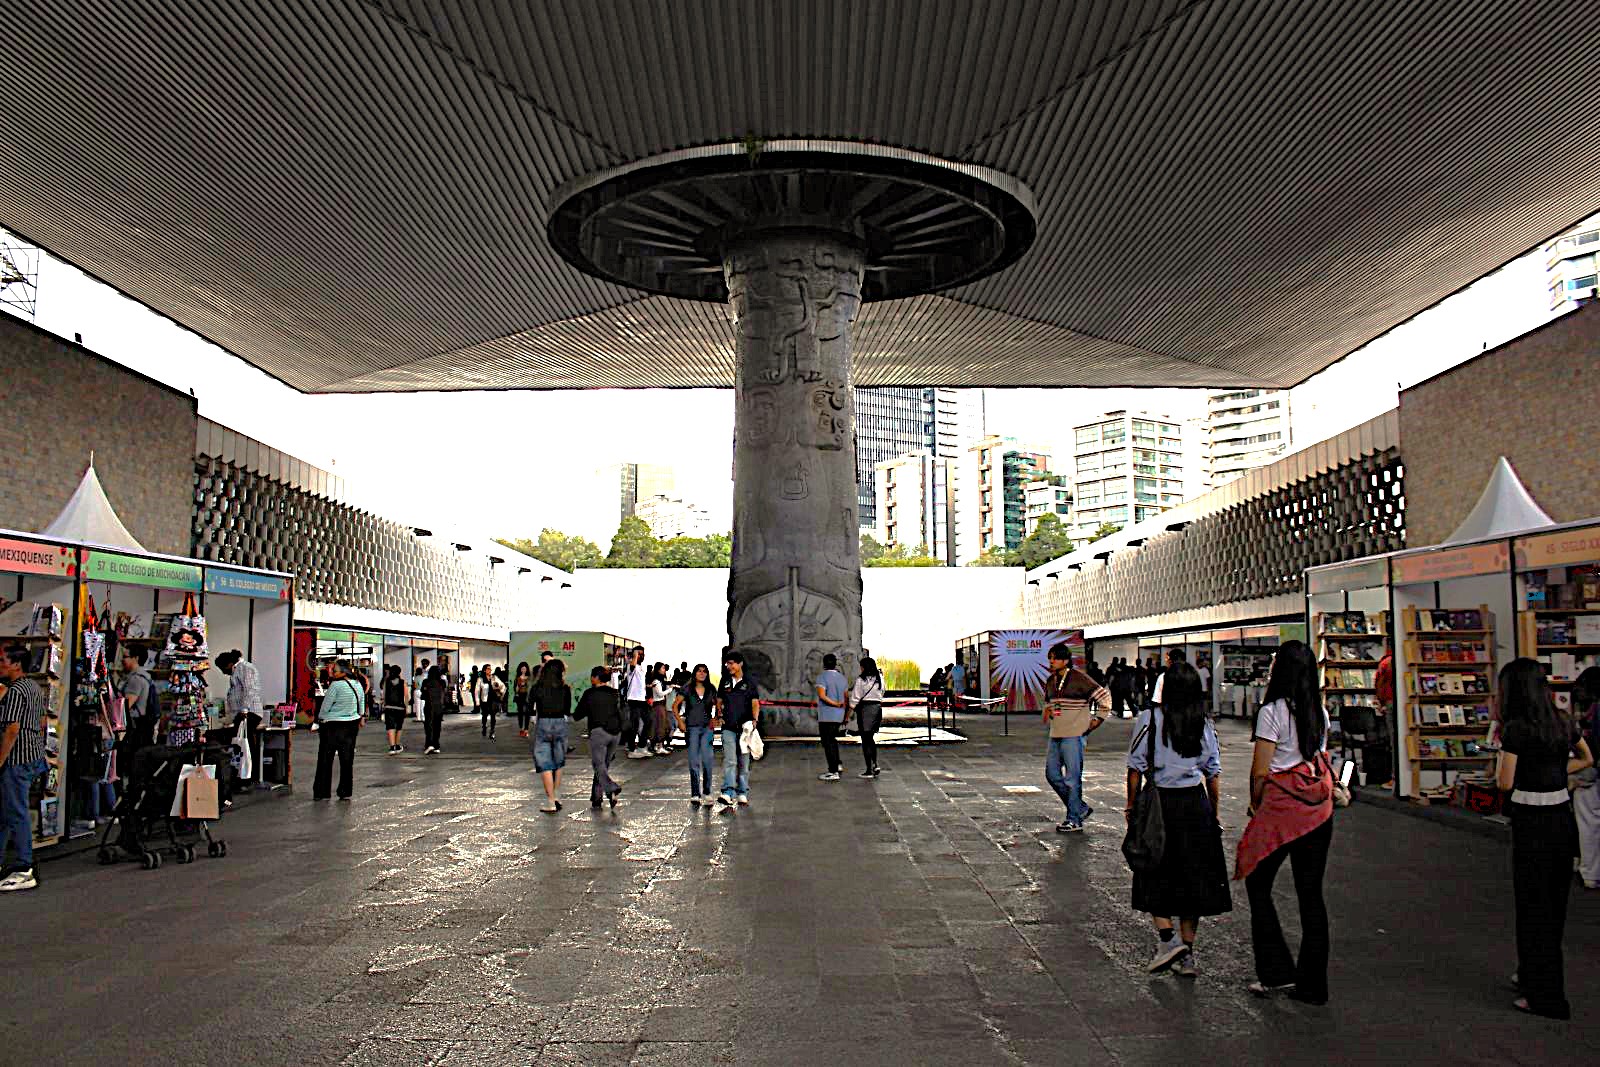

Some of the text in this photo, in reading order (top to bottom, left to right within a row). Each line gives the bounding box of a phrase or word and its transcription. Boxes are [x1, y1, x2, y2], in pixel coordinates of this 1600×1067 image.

[97, 560, 105, 571] 57
[110, 561, 118, 574] EL
[119, 563, 147, 577] COLEGIO
[147, 566, 156, 578] DE
